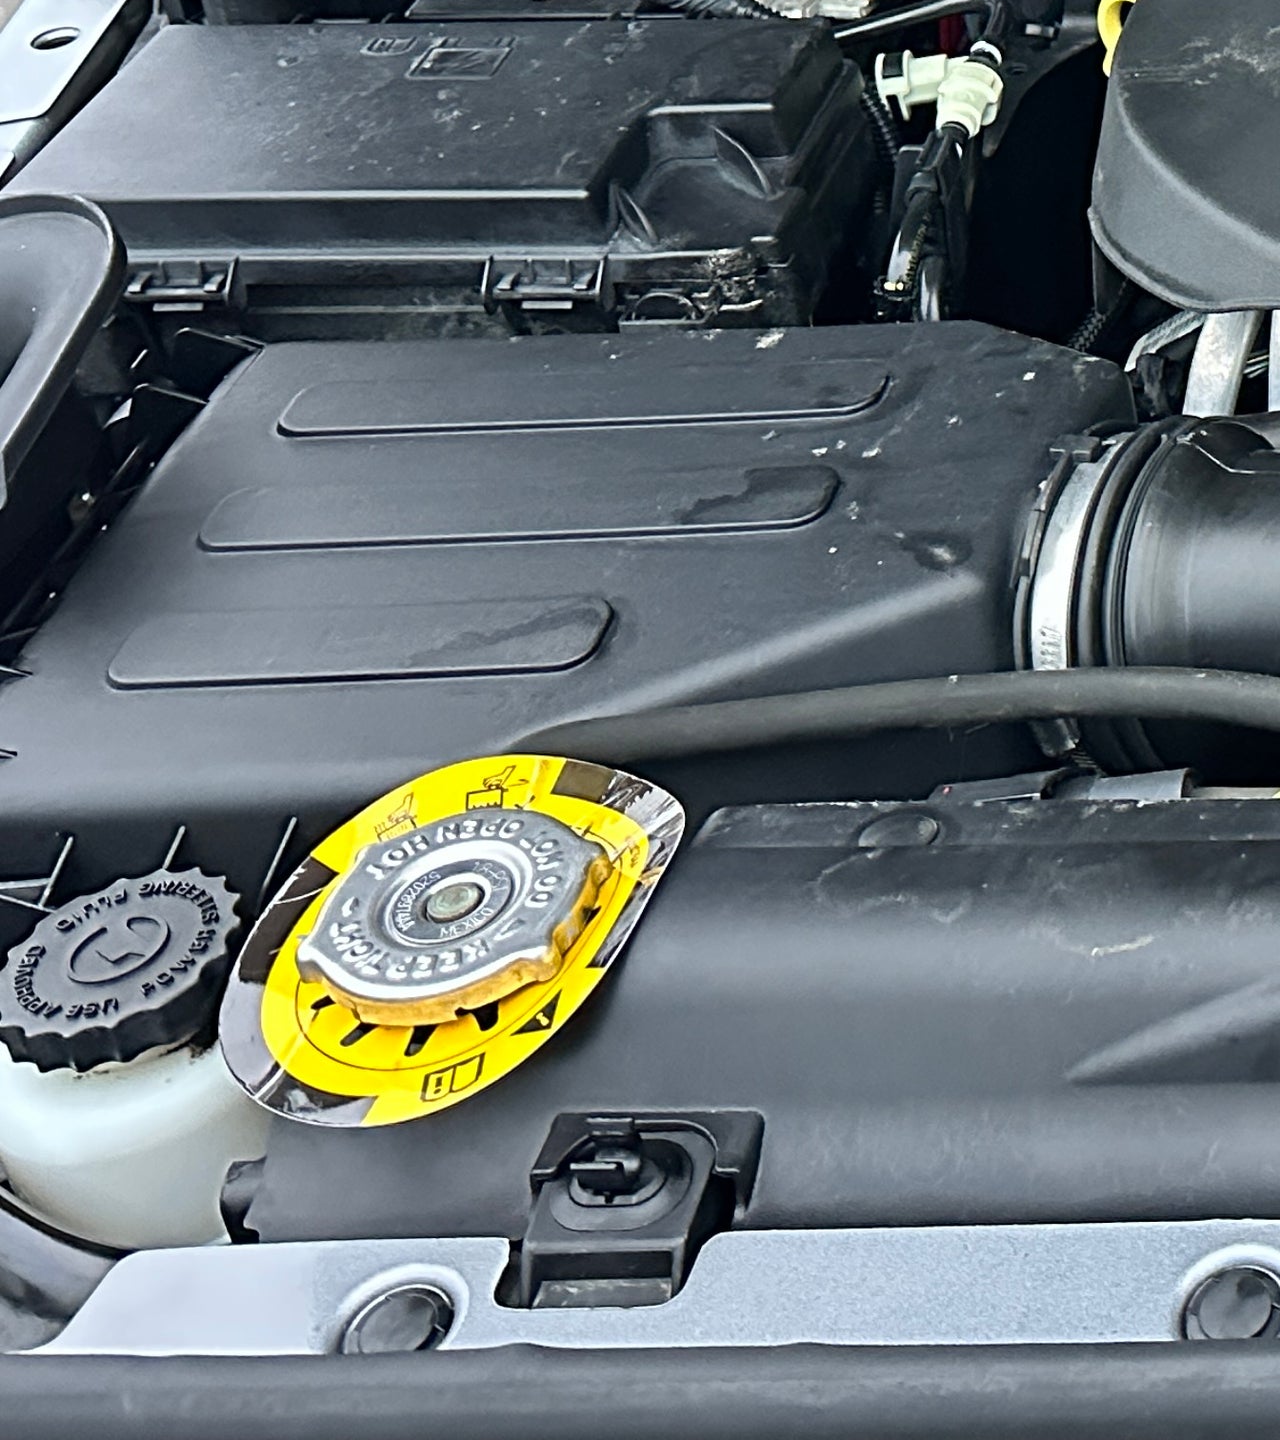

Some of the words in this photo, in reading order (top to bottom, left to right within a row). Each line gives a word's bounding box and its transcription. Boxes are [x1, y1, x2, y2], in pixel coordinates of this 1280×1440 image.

[435, 818, 524, 844] OPEN
[366, 833, 430, 881] HOT
[55, 888, 129, 933] FLUID
[139, 880, 221, 927] STEERING
[440, 906, 495, 938] MEXICO
[386, 937, 490, 981] KEEP
[13, 944, 63, 1019] APPROVED
[65, 996, 120, 1020] USE
